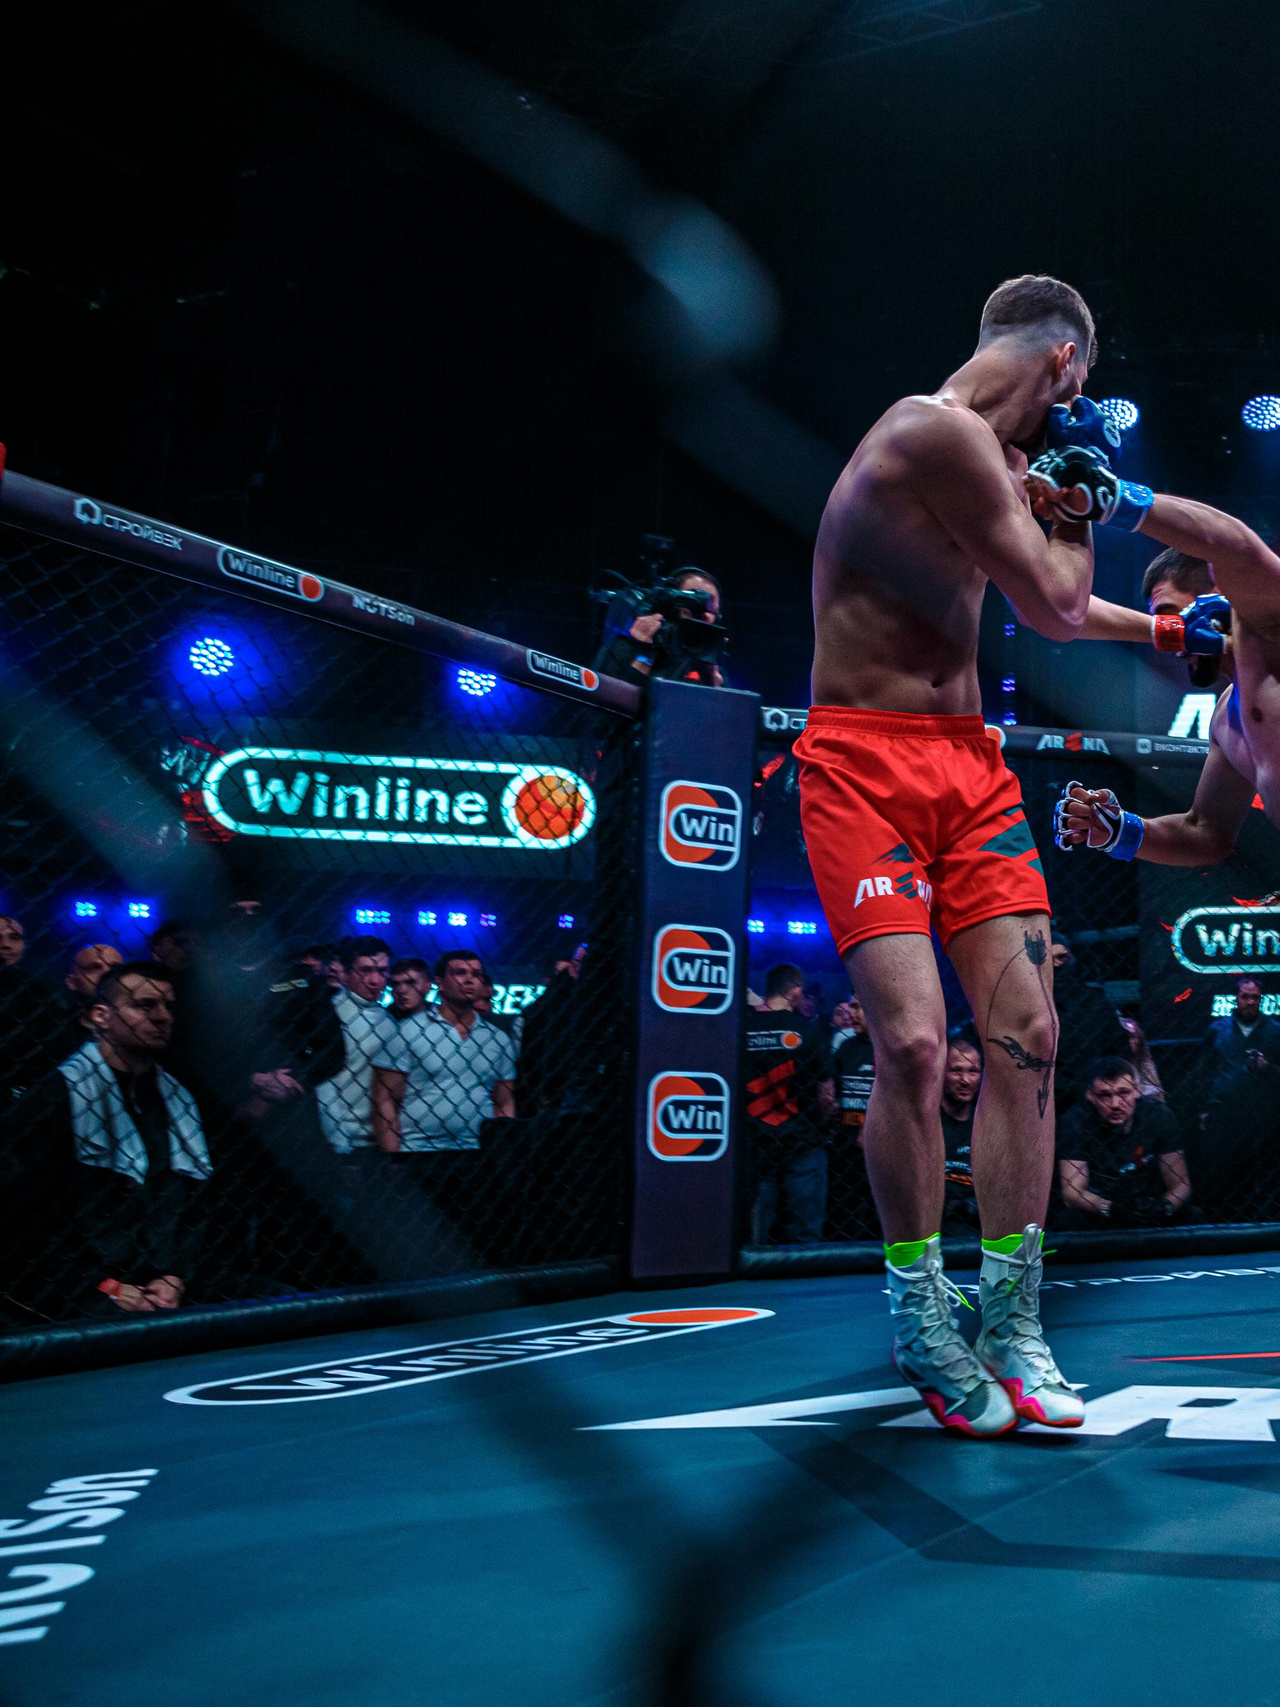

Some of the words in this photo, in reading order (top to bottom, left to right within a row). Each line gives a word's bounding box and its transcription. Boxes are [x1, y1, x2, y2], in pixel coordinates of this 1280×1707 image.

[102, 514, 183, 550] СТРОЙВЕК
[227, 552, 295, 588] Winline
[533, 654, 580, 680] Winline
[1036, 731, 1111, 756] ARENA
[243, 768, 489, 826] Winline
[679, 812, 734, 844] Win
[672, 956, 727, 985] Win
[667, 1104, 722, 1130] Win
[230, 1327, 649, 1391] Winline
